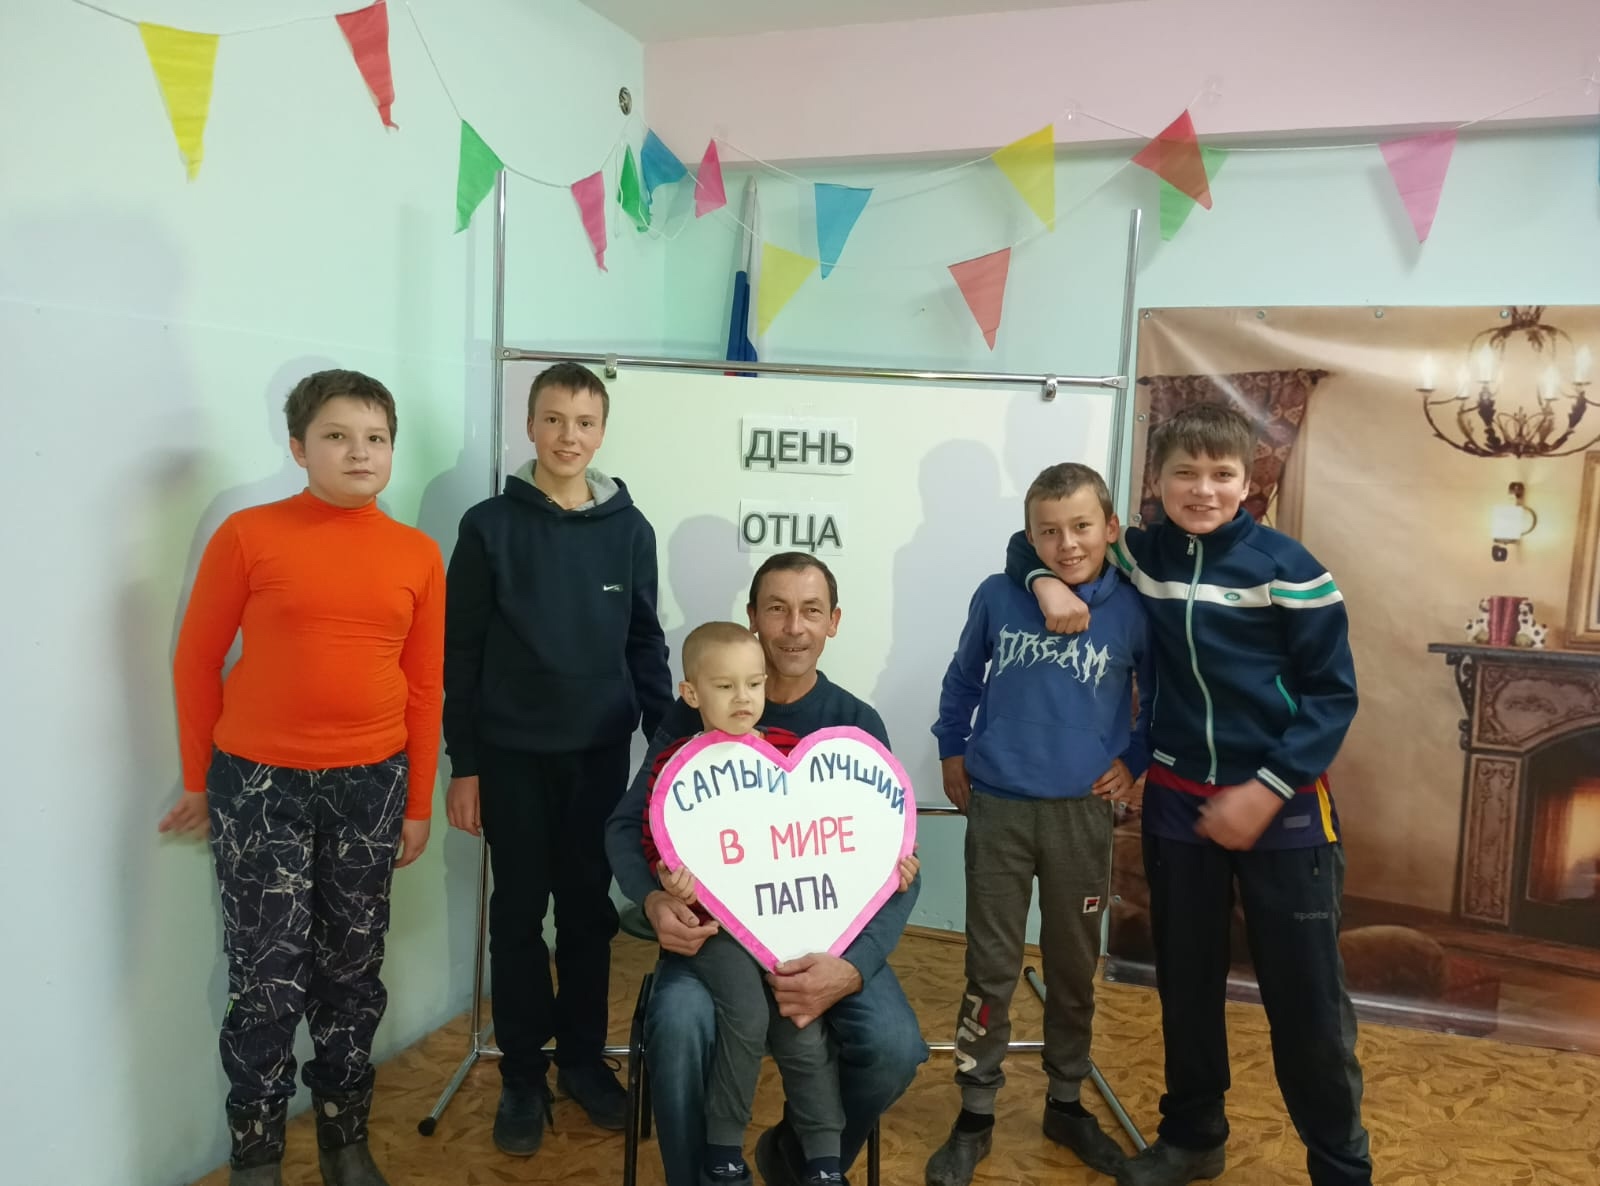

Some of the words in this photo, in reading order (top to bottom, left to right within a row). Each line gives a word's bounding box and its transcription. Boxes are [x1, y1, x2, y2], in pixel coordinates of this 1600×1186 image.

[743, 429, 854, 470] ДЕНЬ
[742, 512, 842, 552] ОТЦА
[996, 624, 1113, 692] DREAM
[672, 759, 788, 812] САМЫЙ
[809, 752, 906, 815] ЛУЧШИЙ
[718, 828, 745, 865] В
[769, 815, 856, 860] МИРЕ
[754, 872, 839, 916] ПАПА
